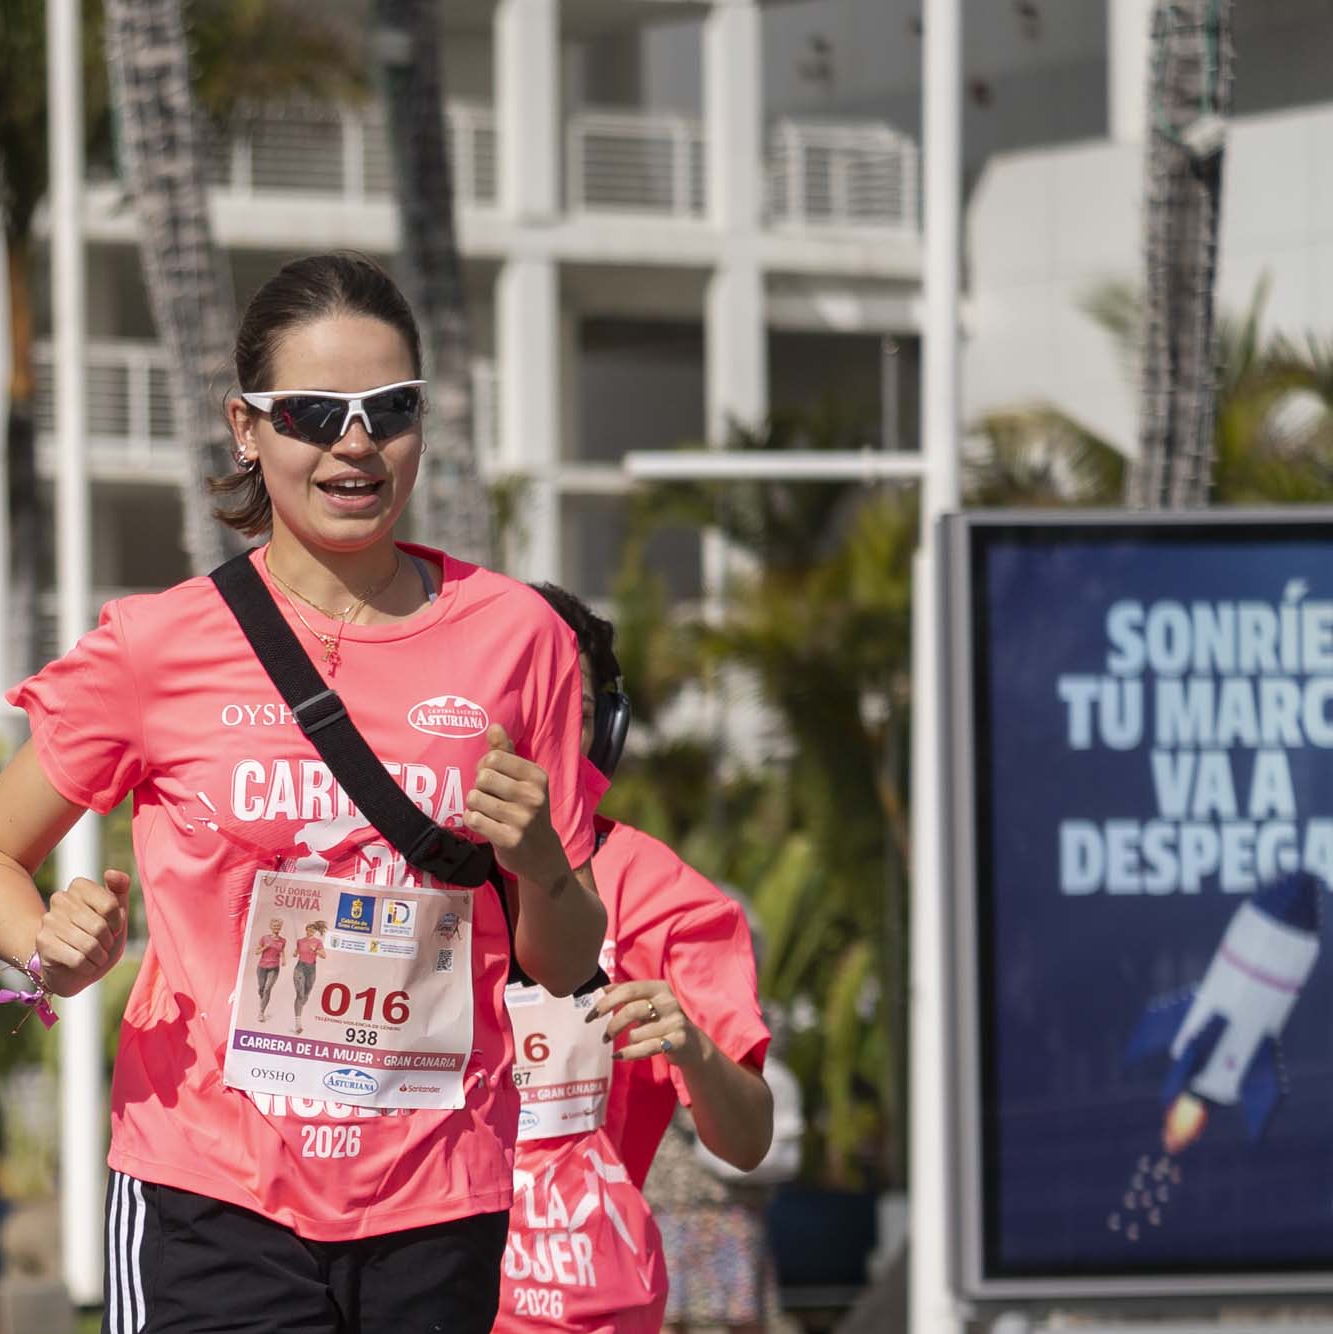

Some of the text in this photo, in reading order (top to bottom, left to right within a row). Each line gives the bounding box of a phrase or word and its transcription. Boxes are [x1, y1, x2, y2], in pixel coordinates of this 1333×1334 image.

[1106, 578, 1333, 677] SONRÍE
[221, 704, 299, 726] OYSH
[415, 710, 483, 729] ASTURIANA
[1058, 674, 1144, 749] TU
[1150, 750, 1296, 820] VA A
[274, 886, 322, 898] TU DORSAL
[274, 895, 321, 912] SUMA
[321, 983, 410, 1025] 016
[345, 1028, 378, 1046] 938
[239, 1034, 456, 1069] CARRERA DE LA MUJER GRAN CANARIA
[251, 1067, 295, 1083] OYSHO
[327, 1076, 374, 1091] ASTURIANA
[408, 1084, 441, 1094] Santander
[537, 1087, 565, 1100] GRAN
[301, 1125, 362, 1158] 2026
[526, 1183, 570, 1229] LA
[505, 1231, 597, 1288] UJER
[514, 1288, 563, 1319] 2026
